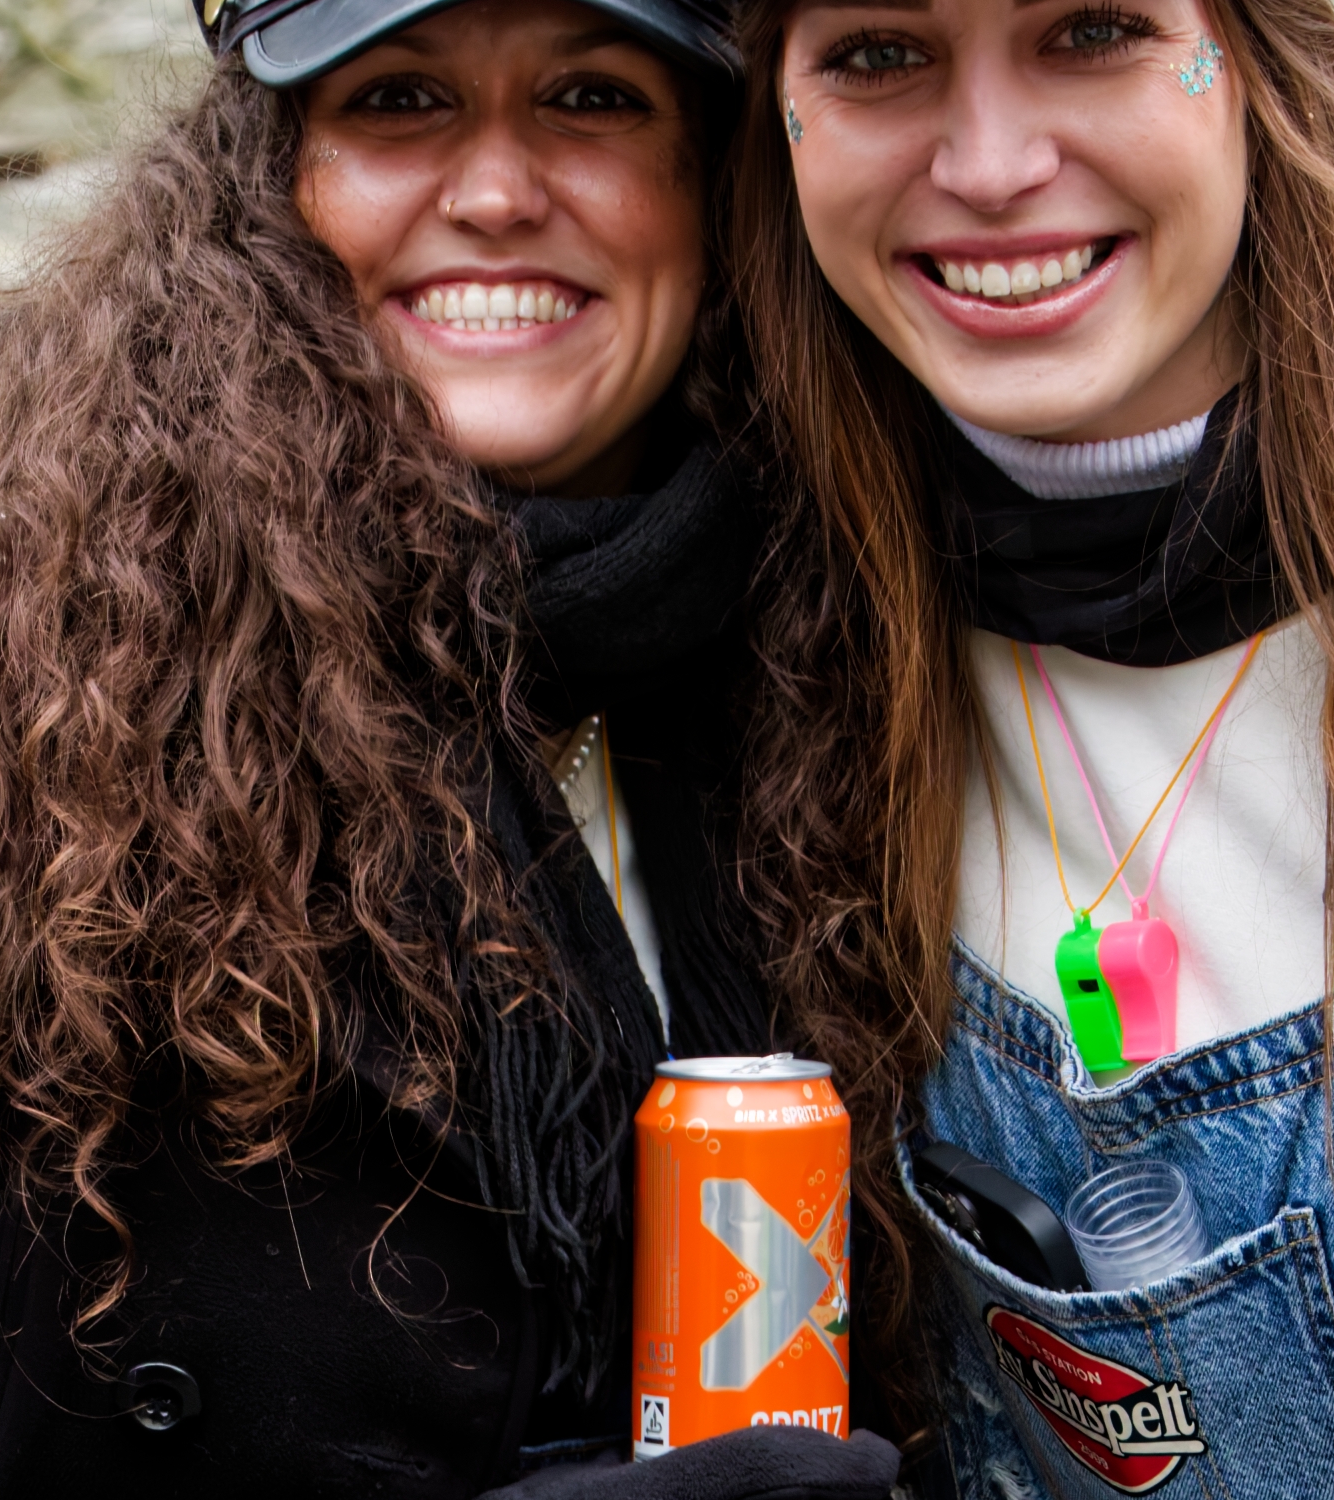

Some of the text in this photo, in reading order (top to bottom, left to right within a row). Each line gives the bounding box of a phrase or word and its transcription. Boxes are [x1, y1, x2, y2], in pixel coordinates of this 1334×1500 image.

[781, 1104, 822, 1124] SPRITZ
[1042, 1348, 1102, 1386] STATION
[1032, 1358, 1196, 1457] Sinspelt
